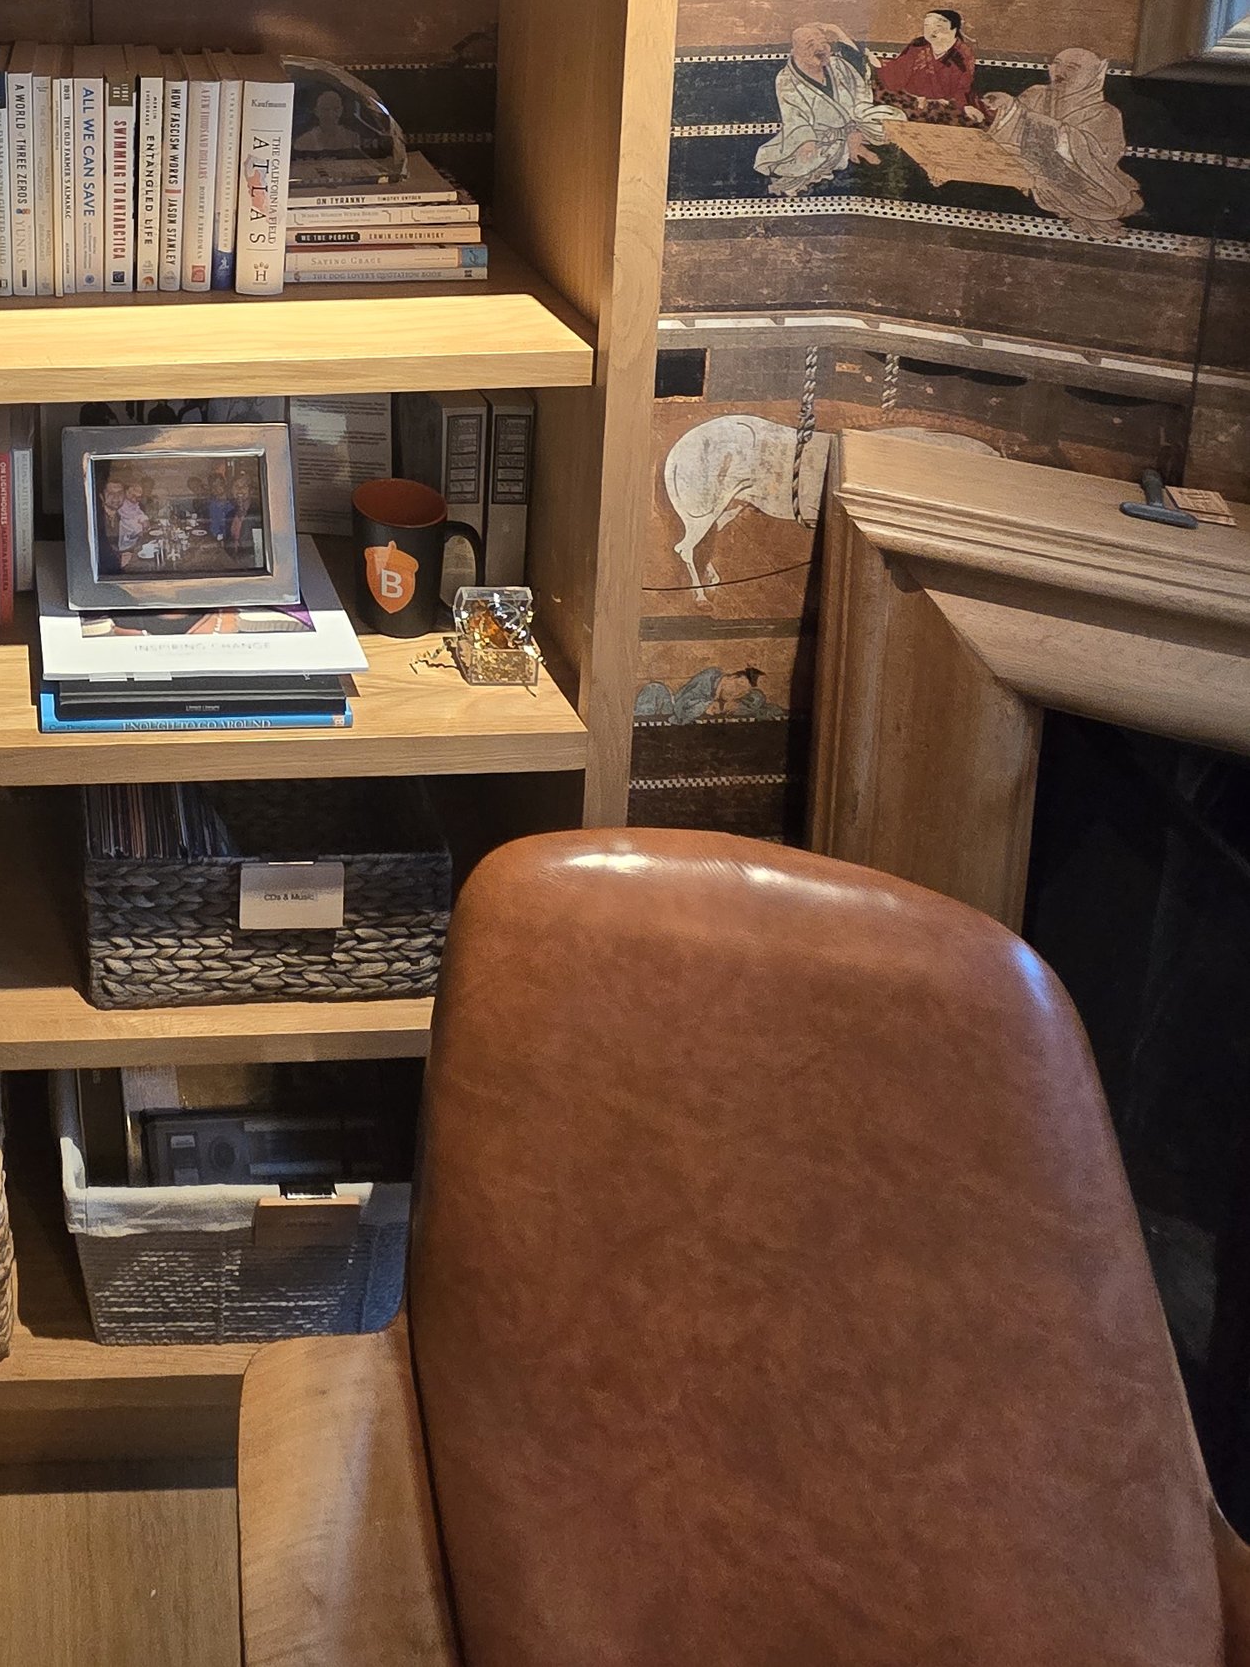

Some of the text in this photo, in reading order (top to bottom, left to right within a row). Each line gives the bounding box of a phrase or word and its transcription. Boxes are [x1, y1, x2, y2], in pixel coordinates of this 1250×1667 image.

[82, 86, 96, 217] ALL WE CAN SAVE
[112, 119, 128, 260] SWIMMING TO ANTARCTICA
[249, 135, 270, 245] ATLAS
[379, 568, 403, 599] B
[263, 892, 315, 902] CDs & Music
